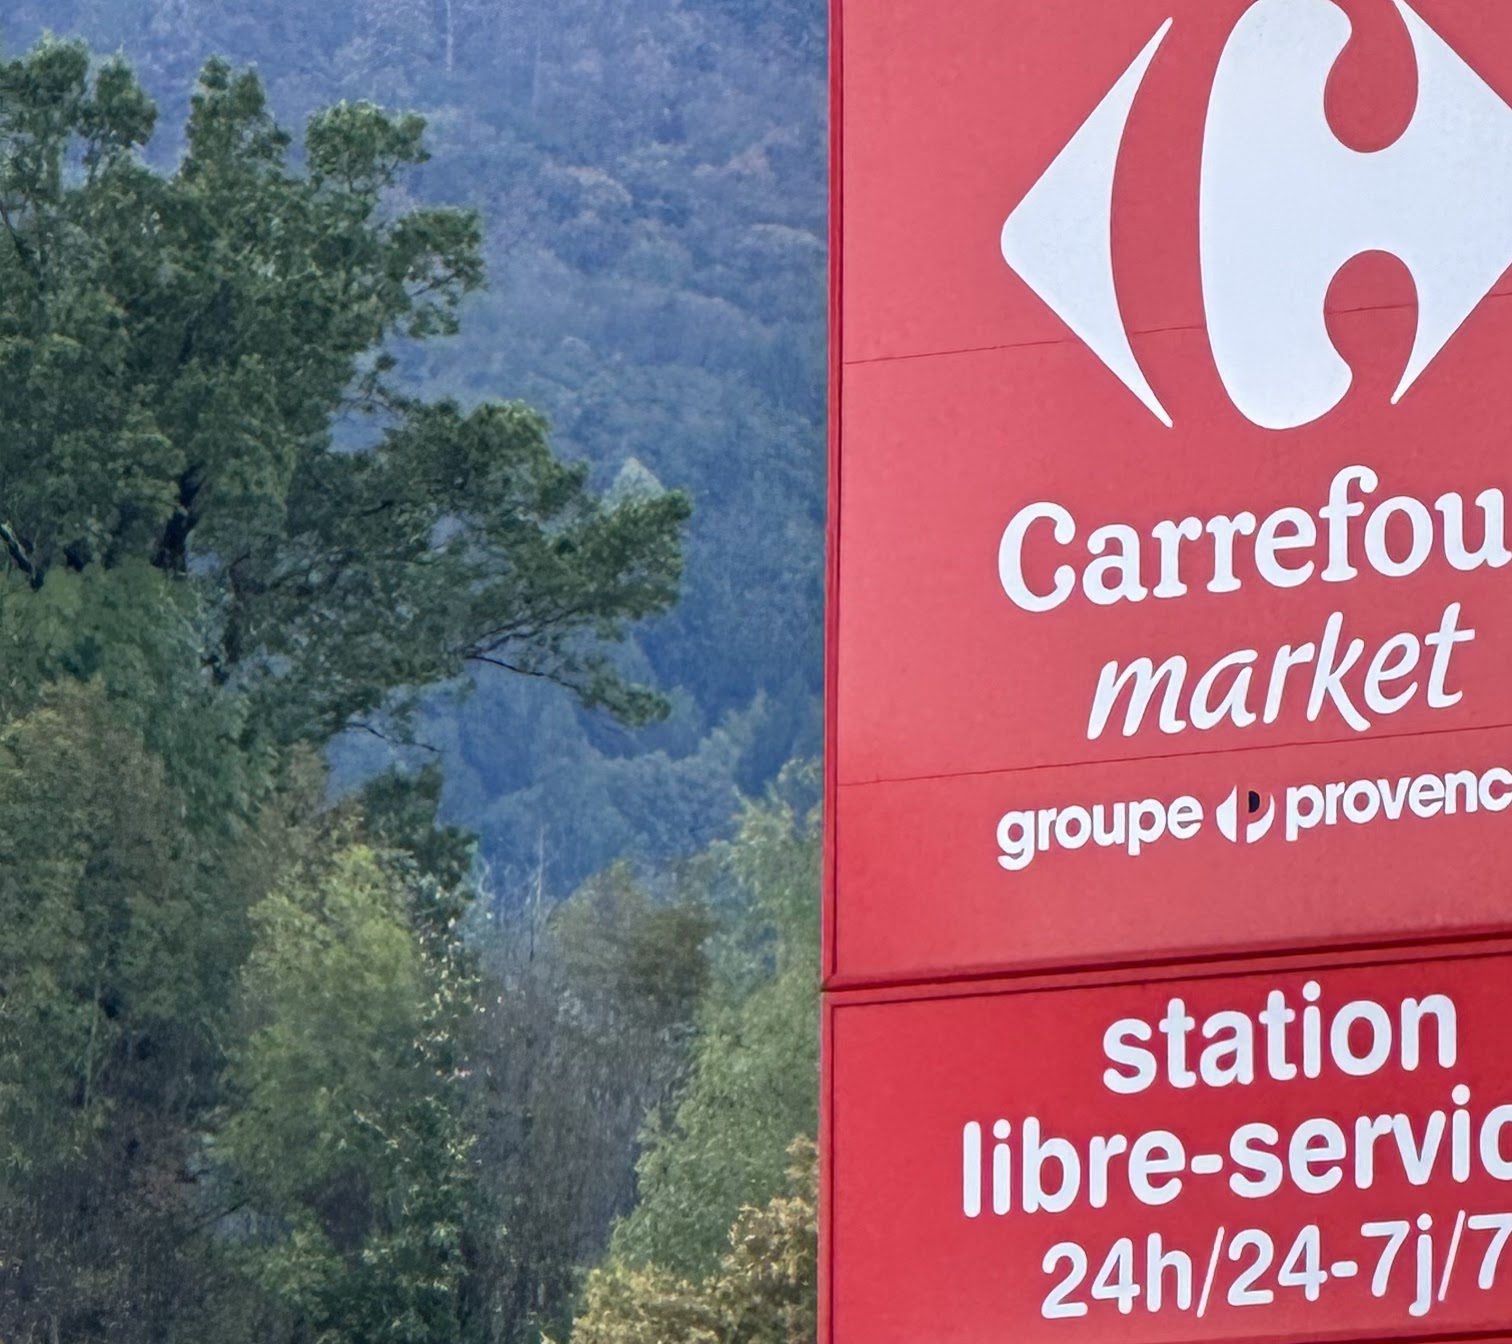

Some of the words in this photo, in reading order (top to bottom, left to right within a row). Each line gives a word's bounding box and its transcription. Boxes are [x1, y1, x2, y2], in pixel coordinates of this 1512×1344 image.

[1086, 602, 1475, 740] market
[996, 795, 1203, 870] groupe
[1103, 980, 1457, 1094] station
